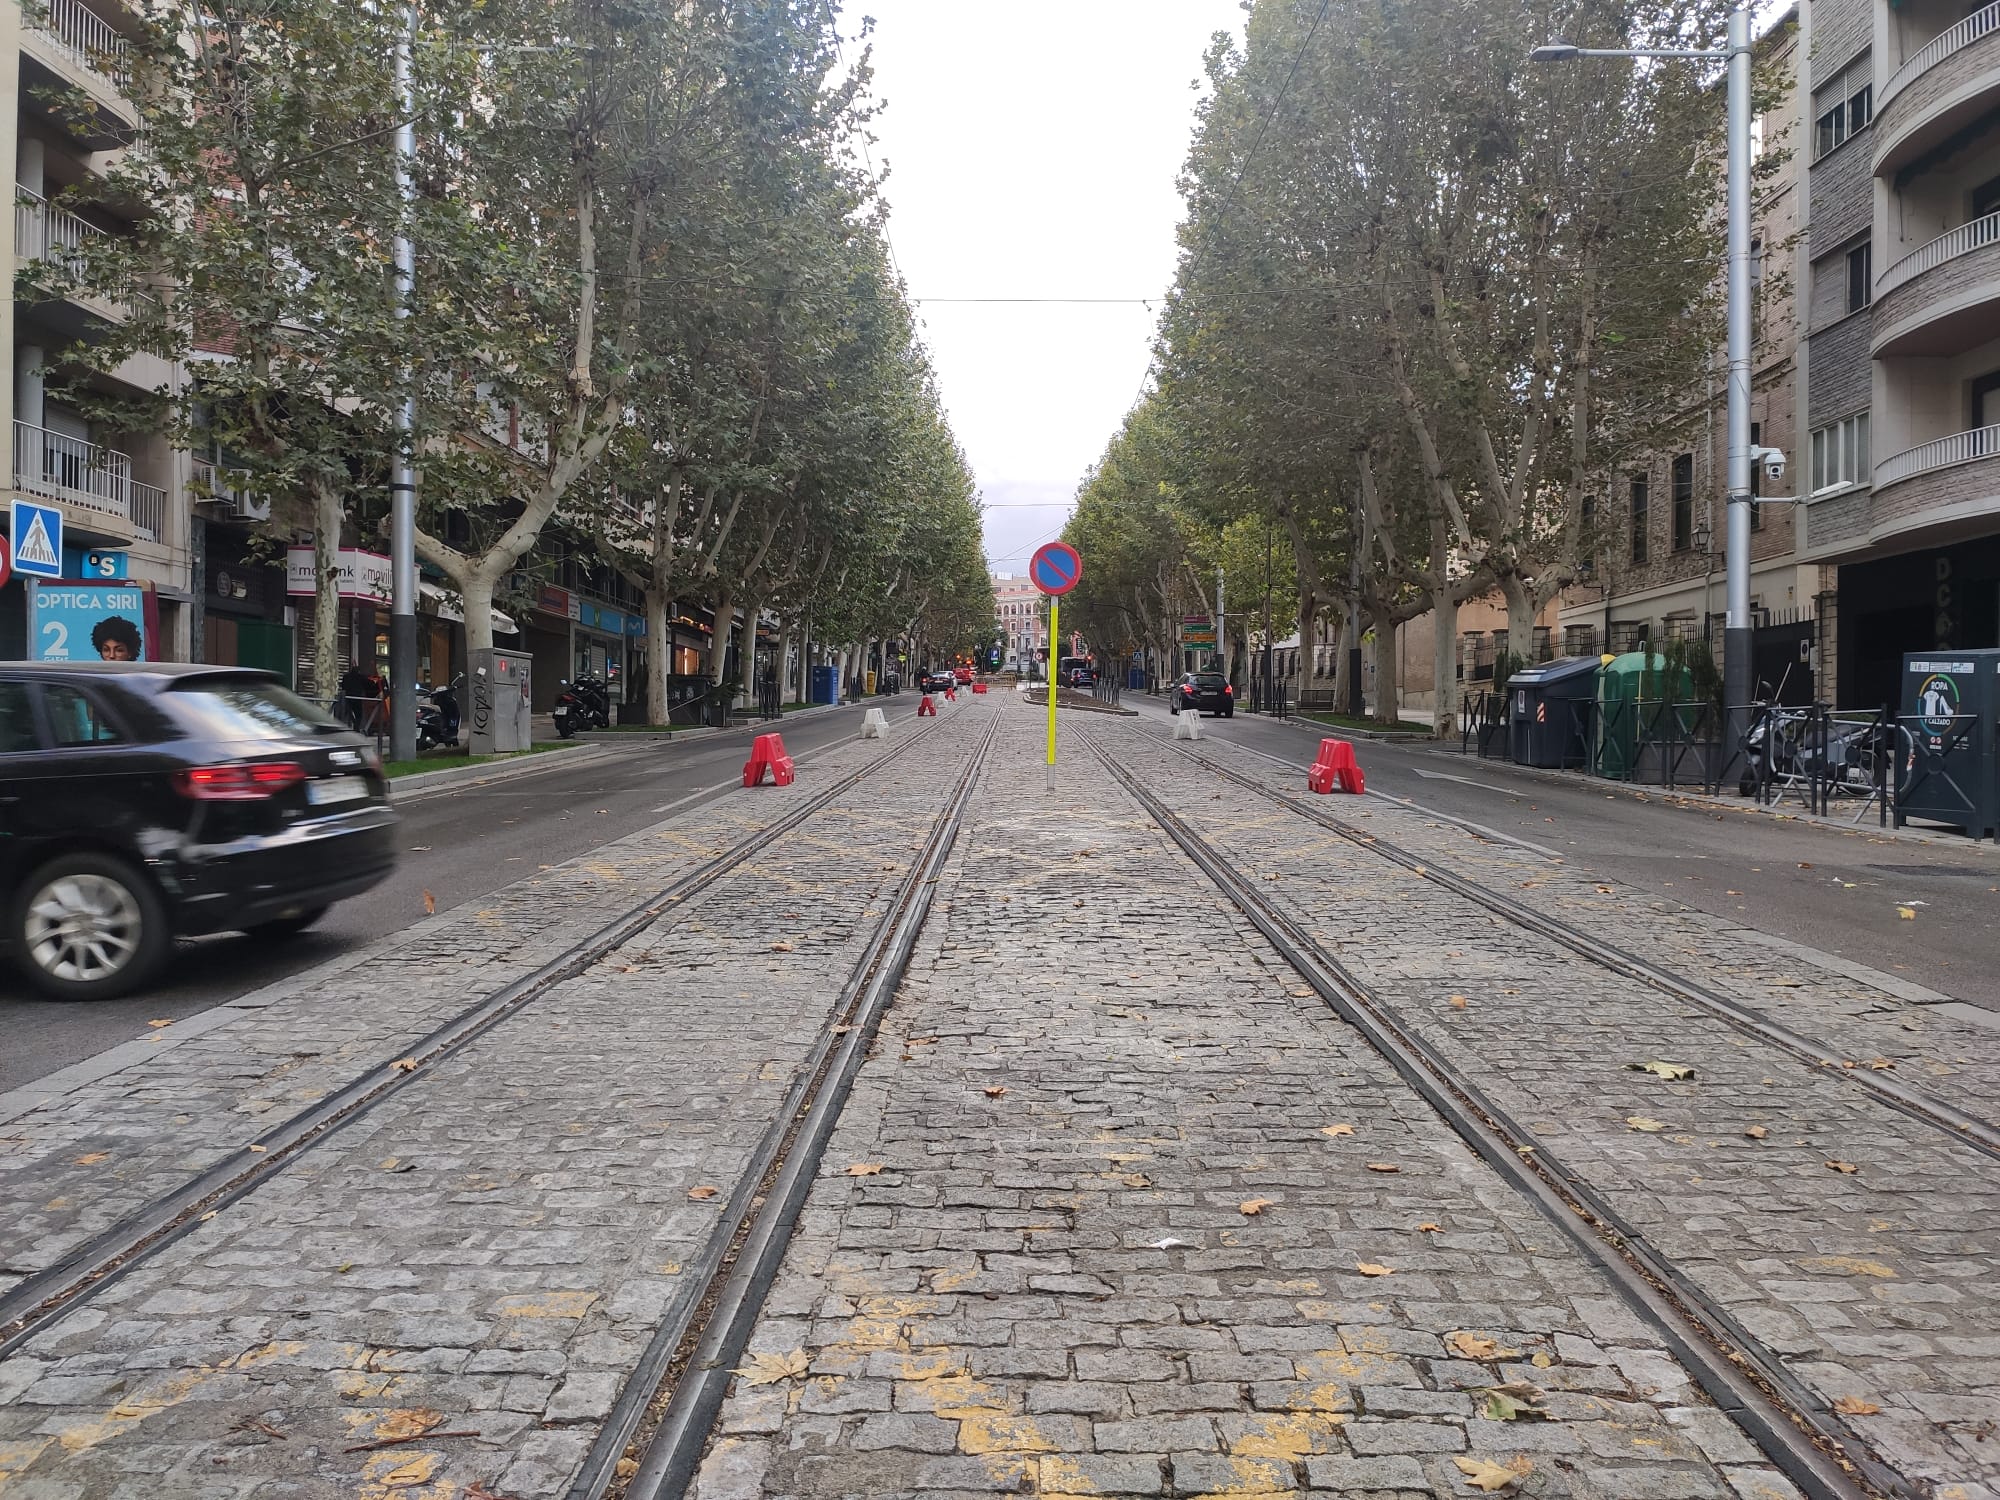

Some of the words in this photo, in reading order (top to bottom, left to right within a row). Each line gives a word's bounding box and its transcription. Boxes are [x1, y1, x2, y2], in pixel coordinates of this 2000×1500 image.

[367, 567, 392, 585] movili
[37, 593, 102, 609] OPTICA
[107, 594, 137, 610] SIRI
[42, 621, 69, 656] 2
[1930, 681, 1949, 691] ROPA
[1928, 718, 1951, 726] CALZADO
